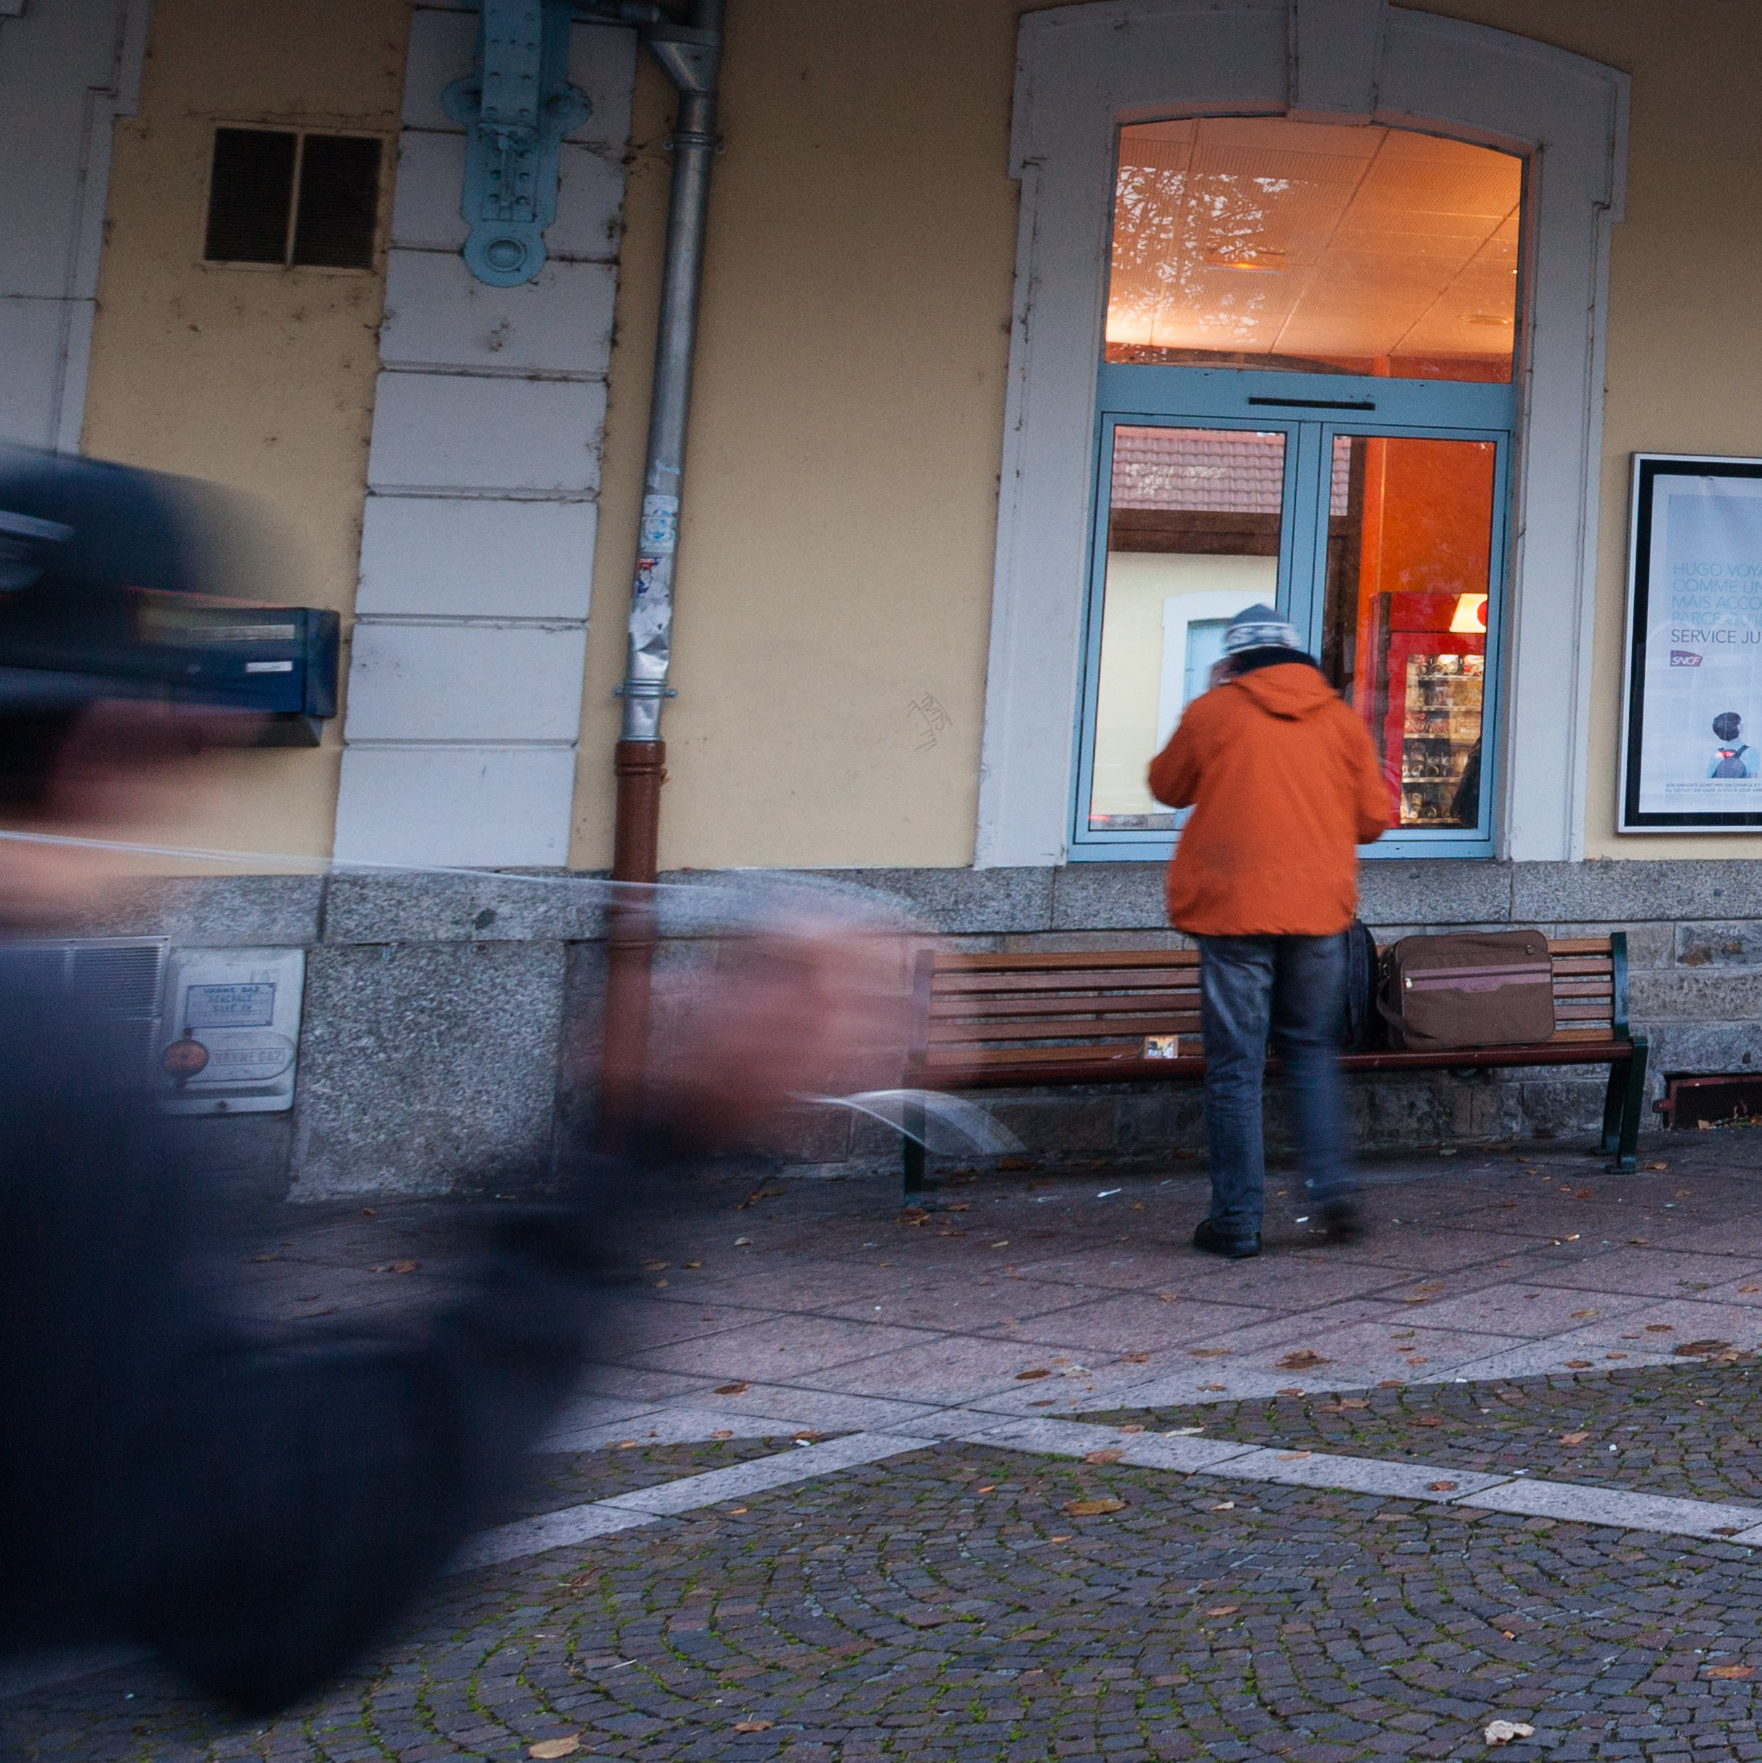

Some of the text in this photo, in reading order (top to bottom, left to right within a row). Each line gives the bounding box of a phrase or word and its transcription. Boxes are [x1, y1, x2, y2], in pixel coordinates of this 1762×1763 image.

[1672, 563, 1722, 577] HUGO
[1672, 579, 1738, 593] COMME
[1671, 595, 1711, 609] MAIS
[1671, 629, 1736, 644] SERVICE
[1672, 656, 1700, 666] SNCF
